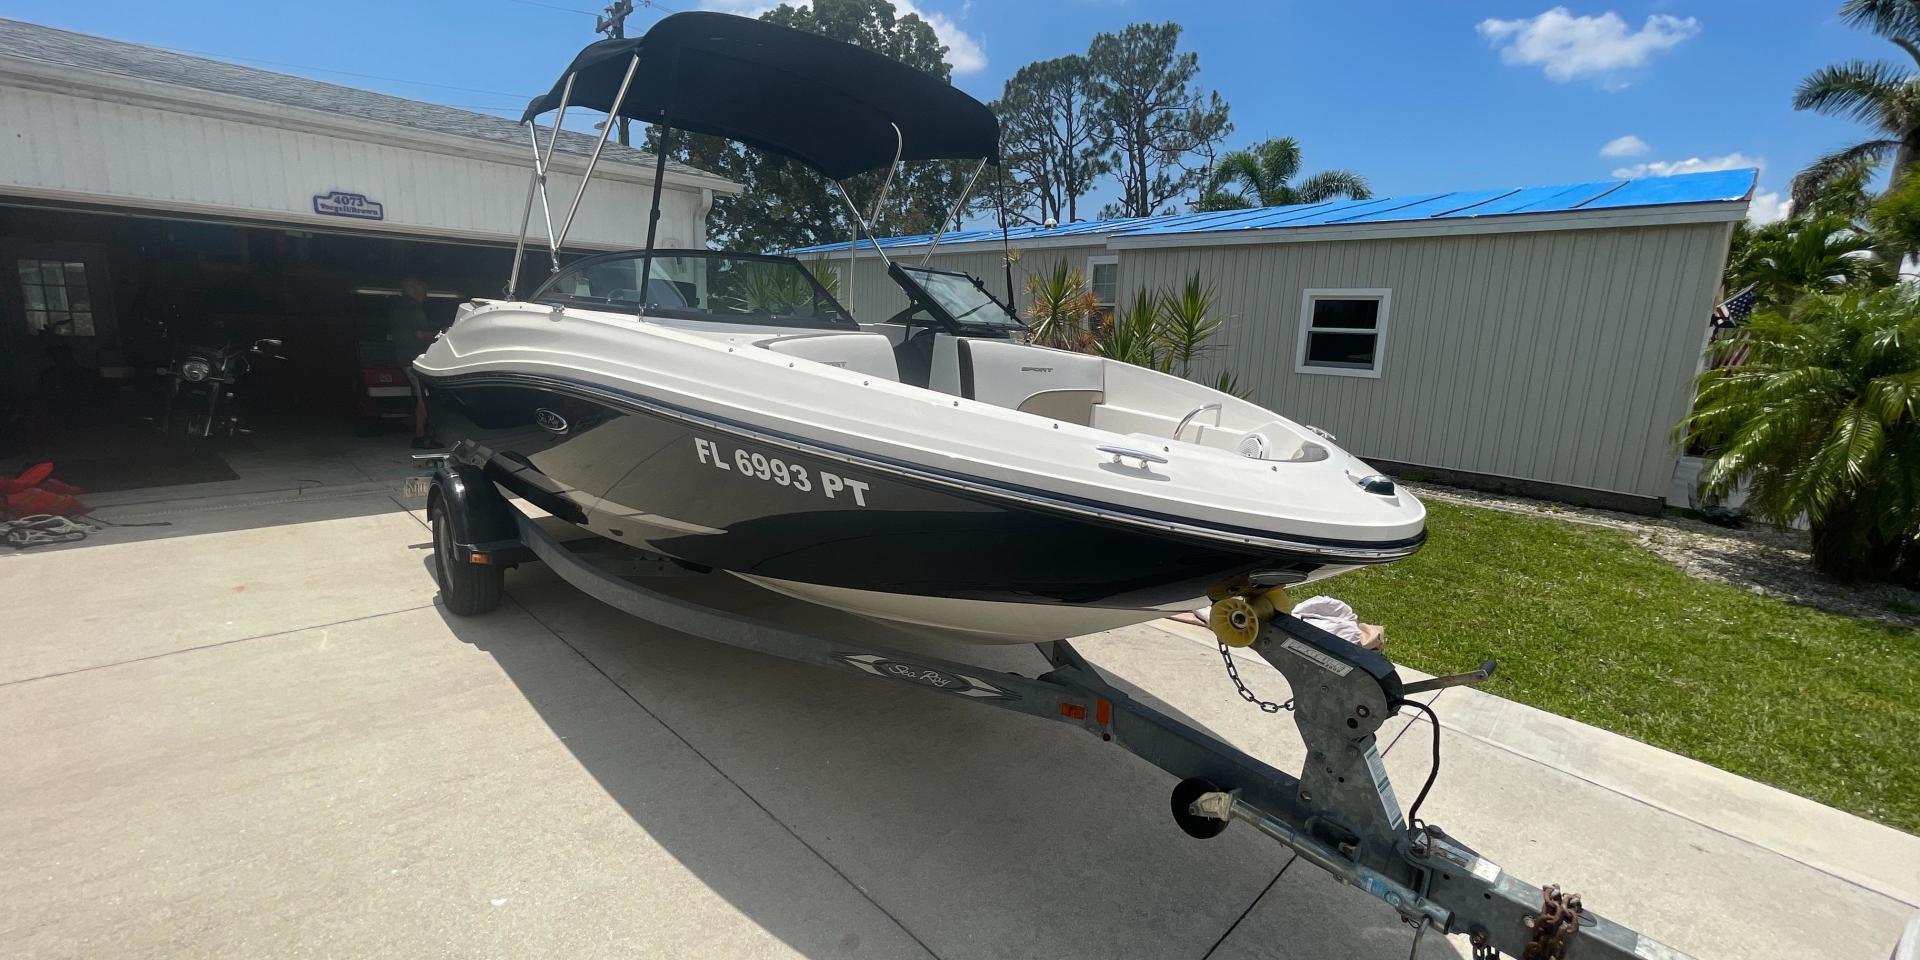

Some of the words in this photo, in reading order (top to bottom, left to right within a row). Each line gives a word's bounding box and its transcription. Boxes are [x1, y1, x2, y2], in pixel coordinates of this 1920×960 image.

[333, 196, 363, 206] 4073
[694, 437, 731, 471] FL
[734, 449, 812, 492] 6993
[820, 471, 869, 507] PT
[888, 665, 917, 678] Sea
[919, 670, 952, 687] Ray
